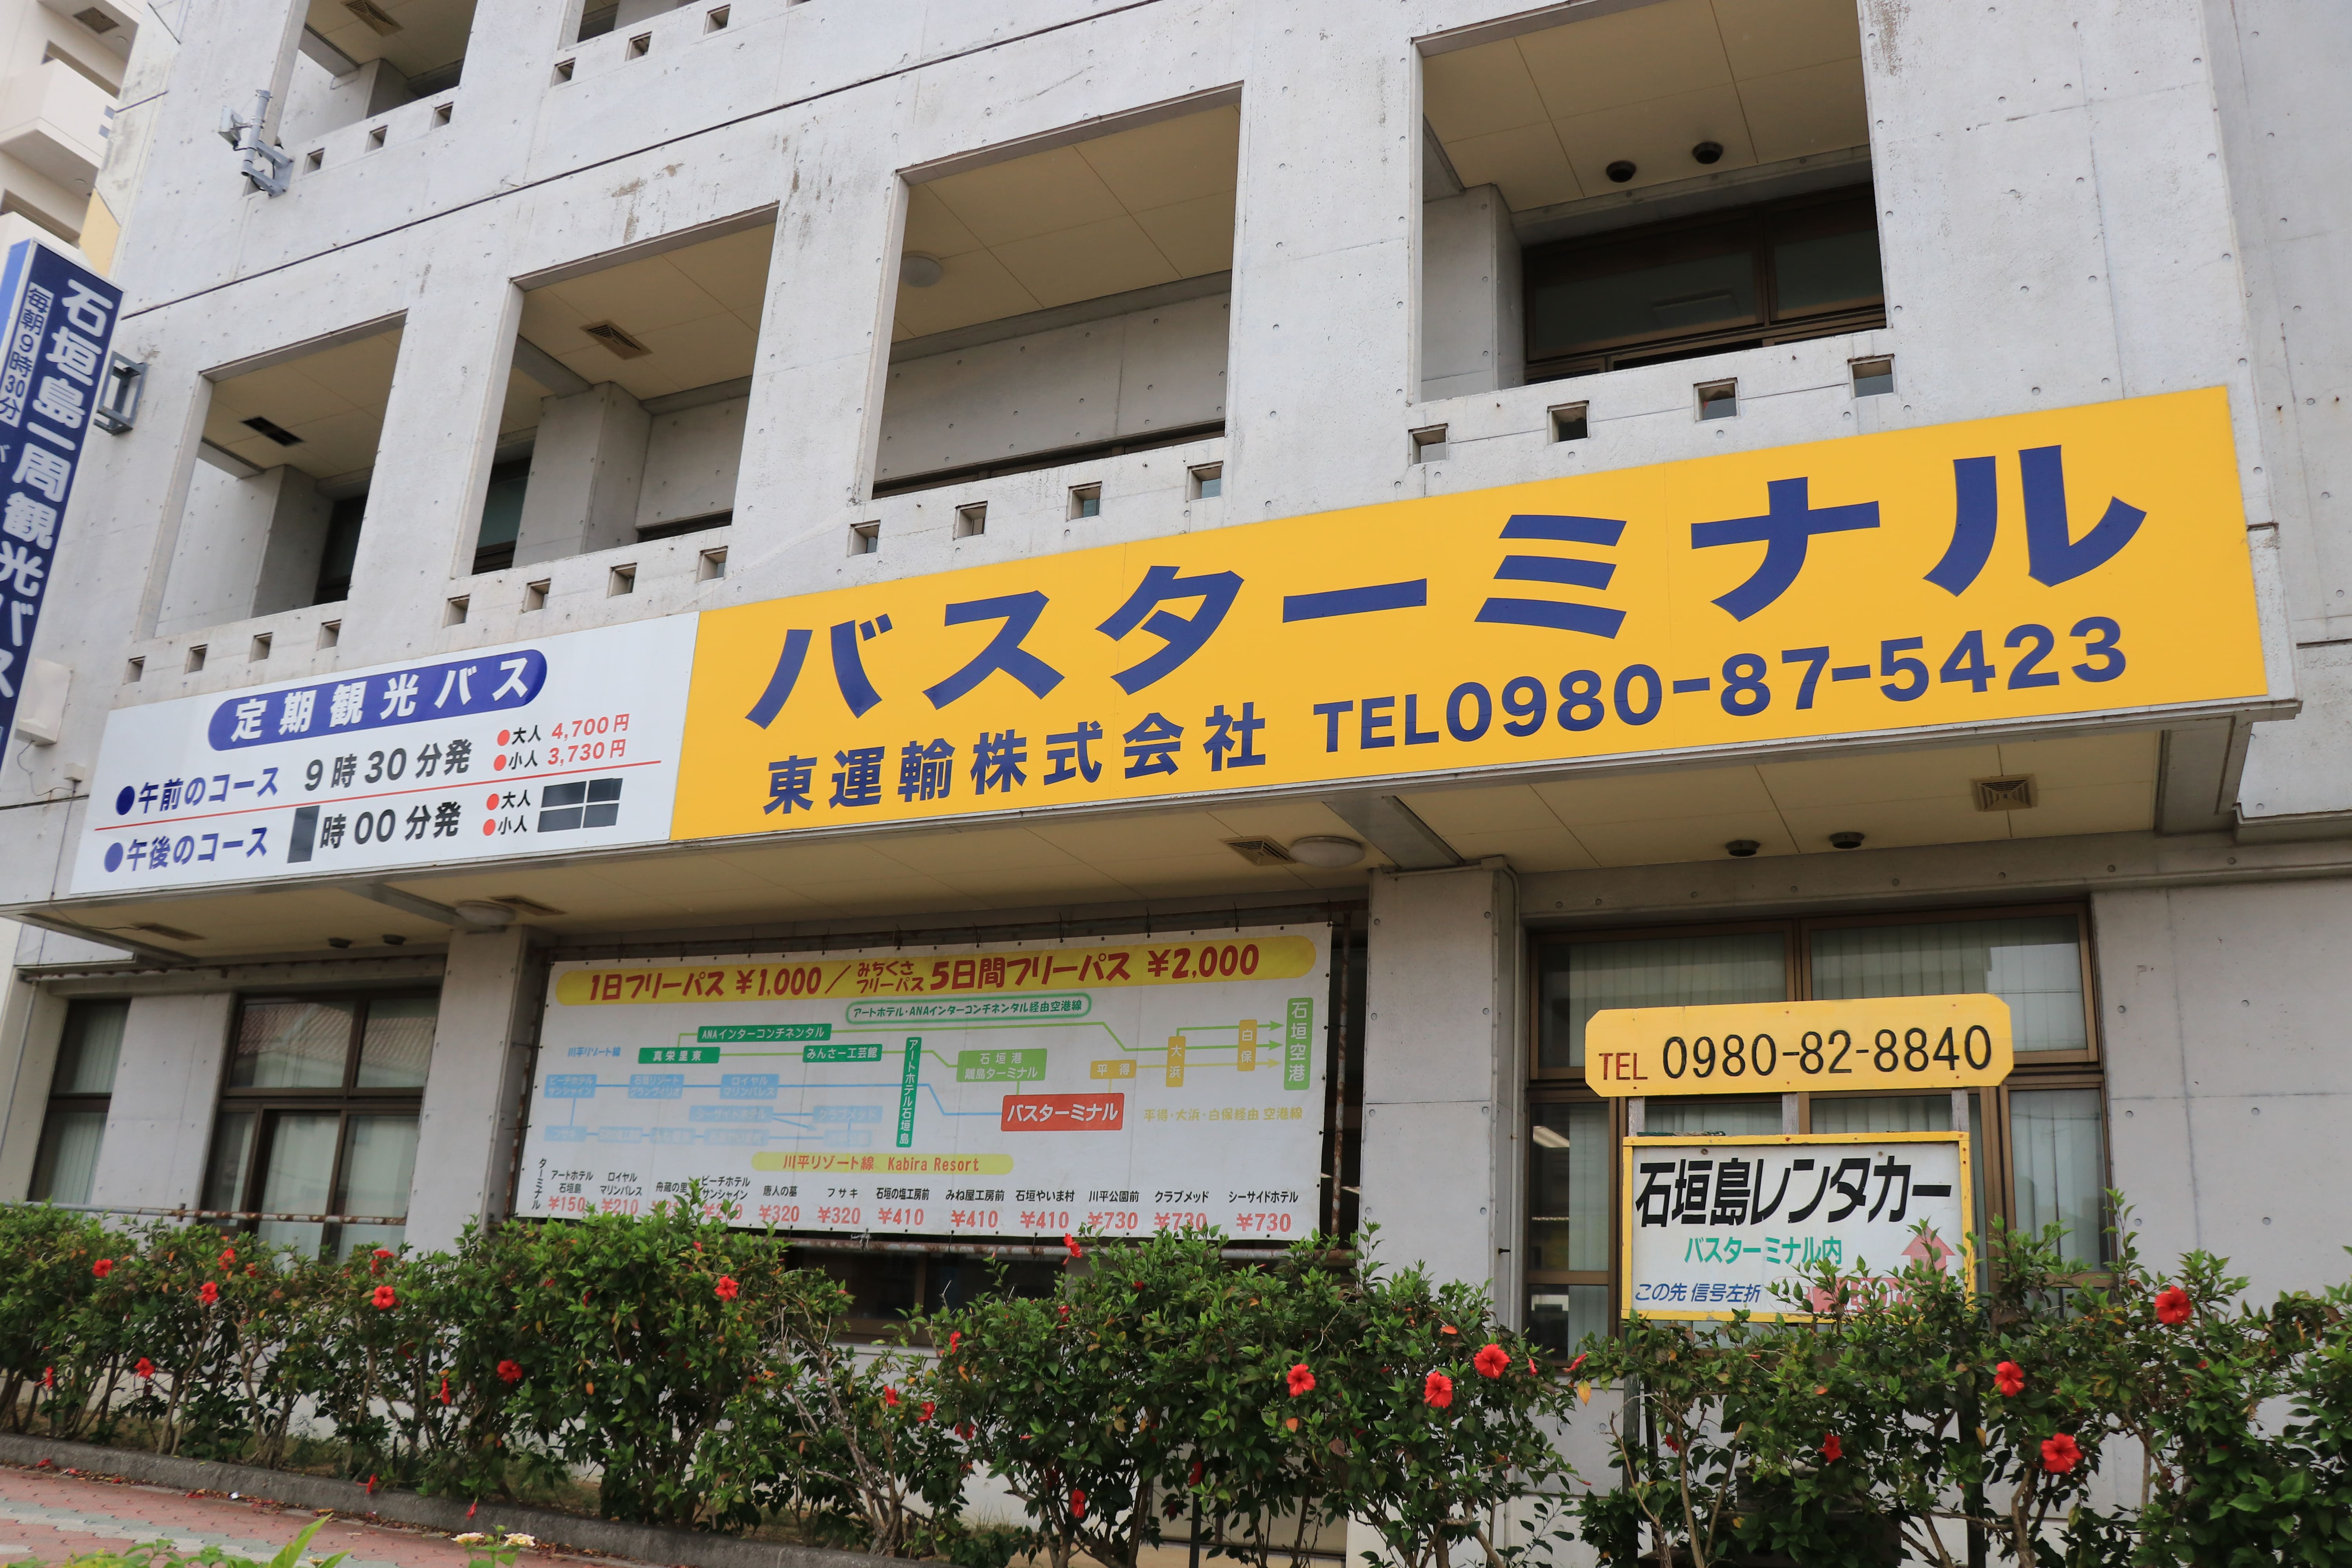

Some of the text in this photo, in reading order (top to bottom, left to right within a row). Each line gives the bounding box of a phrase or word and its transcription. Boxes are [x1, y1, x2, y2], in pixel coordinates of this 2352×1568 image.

[744, 445, 2147, 730] バスターミナル
[231, 657, 528, 742] 定期観光バス
[512, 713, 630, 744] 大人 4,700円
[508, 739, 626, 770] 小人 3,730円
[763, 702, 1267, 816] 東運輸株式会社
[137, 767, 279, 814] 午前のコース
[501, 789, 532, 809] 大人
[498, 815, 528, 836] 小人
[127, 827, 268, 871] 午後のコース
[590, 971, 725, 1001] 1日フリーパス
[736, 967, 822, 997] ¥1,000
[857, 960, 915, 976] みちくさ
[930, 952, 1131, 991] 5日間フリーパス
[1147, 944, 1259, 980] ¥2,000
[856, 976, 924, 994] フリーパス
[702, 1027, 824, 1040] ANAインターコンチネンタル
[1289, 1002, 1308, 1082] 石垣空港
[806, 1046, 878, 1059] みんさー工芸館
[1240, 1029, 1253, 1063] 白保
[1598, 1024, 1992, 1080] TEL 0980-82-8840
[653, 1050, 702, 1062] 真栄里東
[980, 1053, 1022, 1064] 石垣港
[1169, 1045, 1182, 1078] 大浜
[964, 1066, 1038, 1080] 離島ターミナル
[1097, 1063, 1130, 1076] 平得
[731, 1076, 768, 1085] ロイヤル
[1007, 1103, 1118, 1122] バスターミナル
[783, 1155, 979, 1172] 川平リゾート線 Kabira Resort
[532, 1158, 547, 1210] ターミナル
[551, 1170, 594, 1181] アートホテル
[608, 1172, 637, 1183] ロイヤル
[702, 1176, 751, 1187] ビーチホテル
[559, 1183, 582, 1194] 石垣島
[600, 1185, 642, 1196] マリンパレス
[655, 1181, 687, 1193] 舟蔵の里
[702, 1188, 748, 1200] サンシャイン
[763, 1185, 797, 1197] 唐人の墓
[827, 1188, 858, 1199] フサキ
[876, 1187, 930, 1200] 石垣の塩工房前
[945, 1189, 1005, 1202] みね屋工房前
[1016, 1189, 1075, 1203] 石垣やいま村
[1635, 1154, 1952, 1227] 石垣島レンタカー
[548, 1195, 586, 1212] ¥150
[1088, 1190, 1139, 1203] 川平公園前
[1154, 1190, 1209, 1204] クラブメッド
[1229, 1190, 1299, 1203] シーサイドホテル
[601, 1198, 639, 1215] ¥210
[703, 1203, 743, 1220] ¥20
[758, 1204, 800, 1223] ¥320
[817, 1206, 861, 1225] ¥320
[878, 1207, 924, 1226] ¥410
[951, 1209, 999, 1229] ¥410
[1020, 1210, 1070, 1230] ¥410
[1087, 1211, 1138, 1230] ¥730
[1154, 1211, 1208, 1232] ¥730
[1236, 1212, 1292, 1232] ¥730
[1684, 1236, 1842, 1265] バスターミナル内
[1635, 1282, 1763, 1303] この先 信号左折
